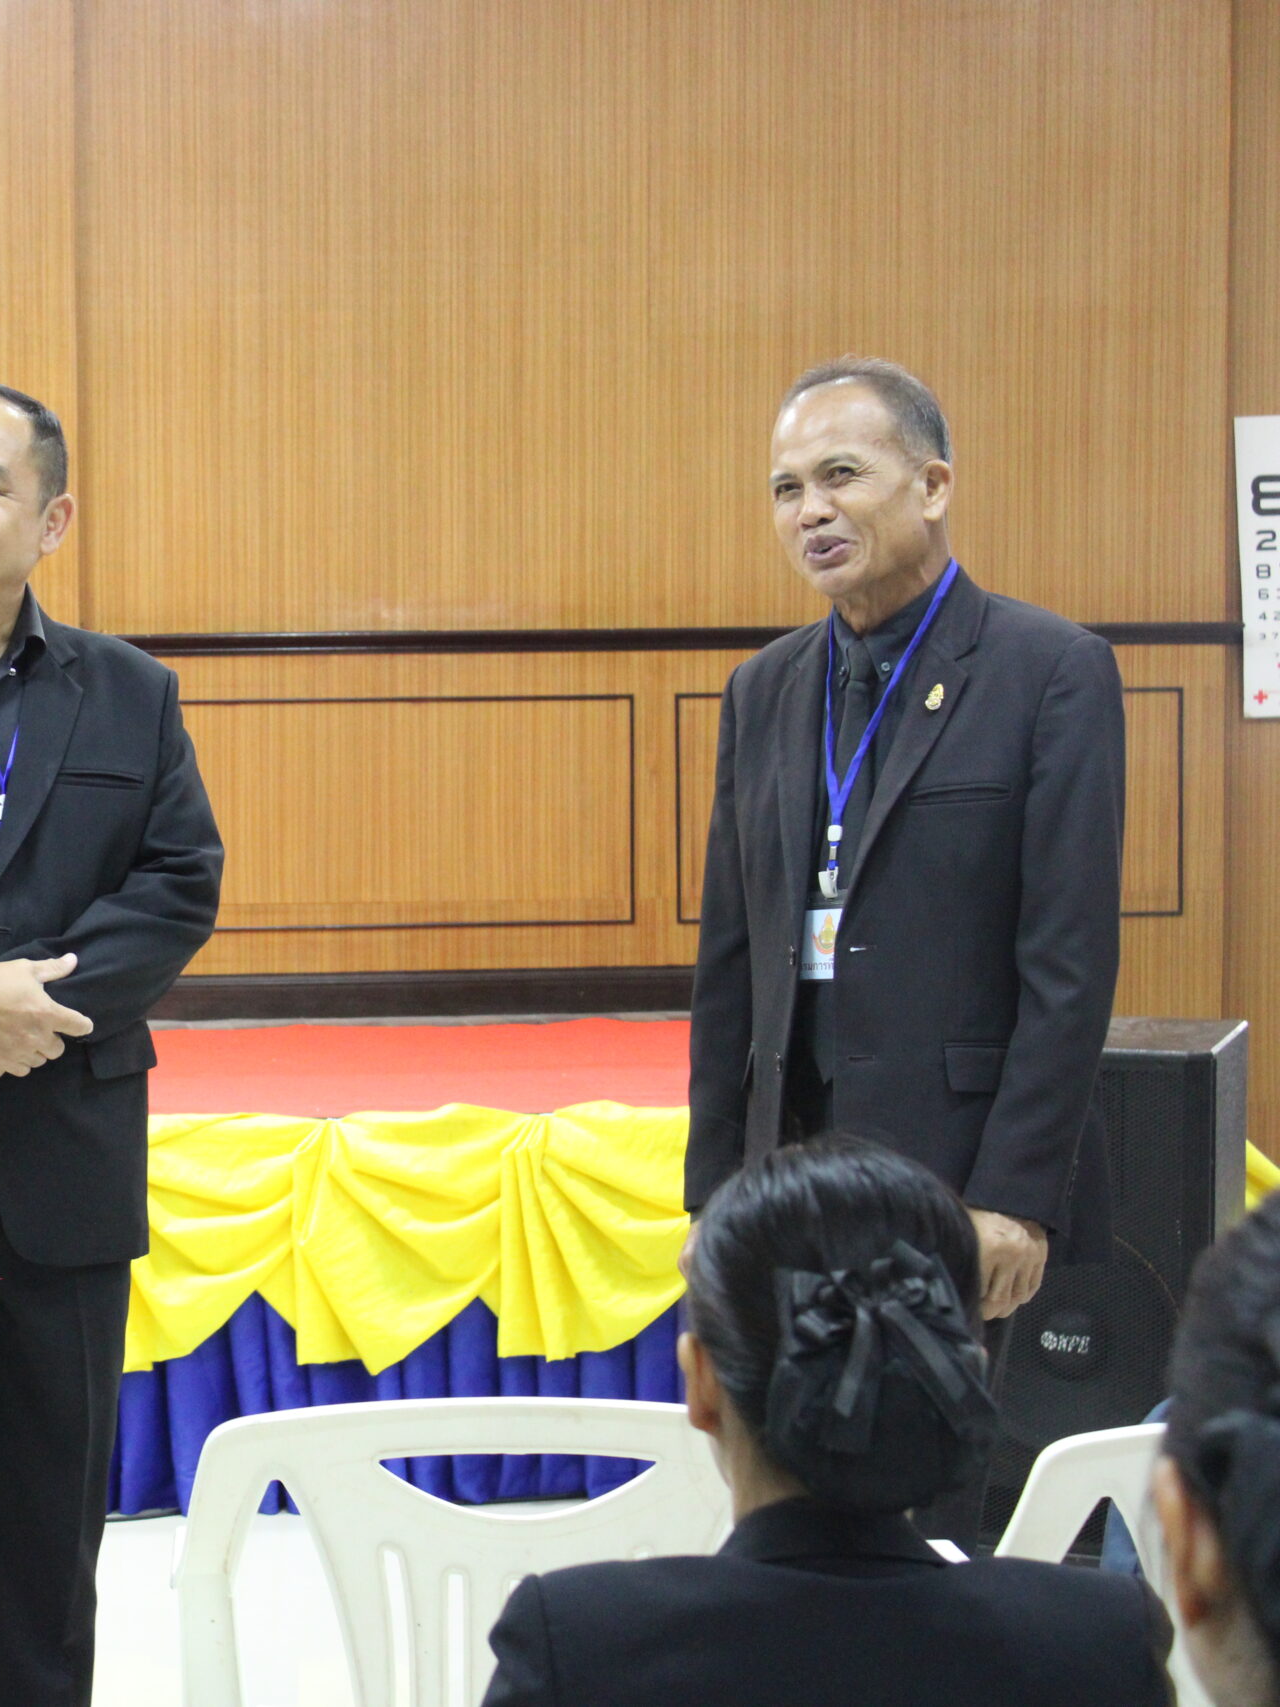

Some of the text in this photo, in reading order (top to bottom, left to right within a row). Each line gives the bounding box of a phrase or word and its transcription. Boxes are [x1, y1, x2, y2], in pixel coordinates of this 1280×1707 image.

[1256, 529, 1277, 551] 2
[1256, 563, 1271, 579] 8
[1258, 588, 1269, 600] 6
